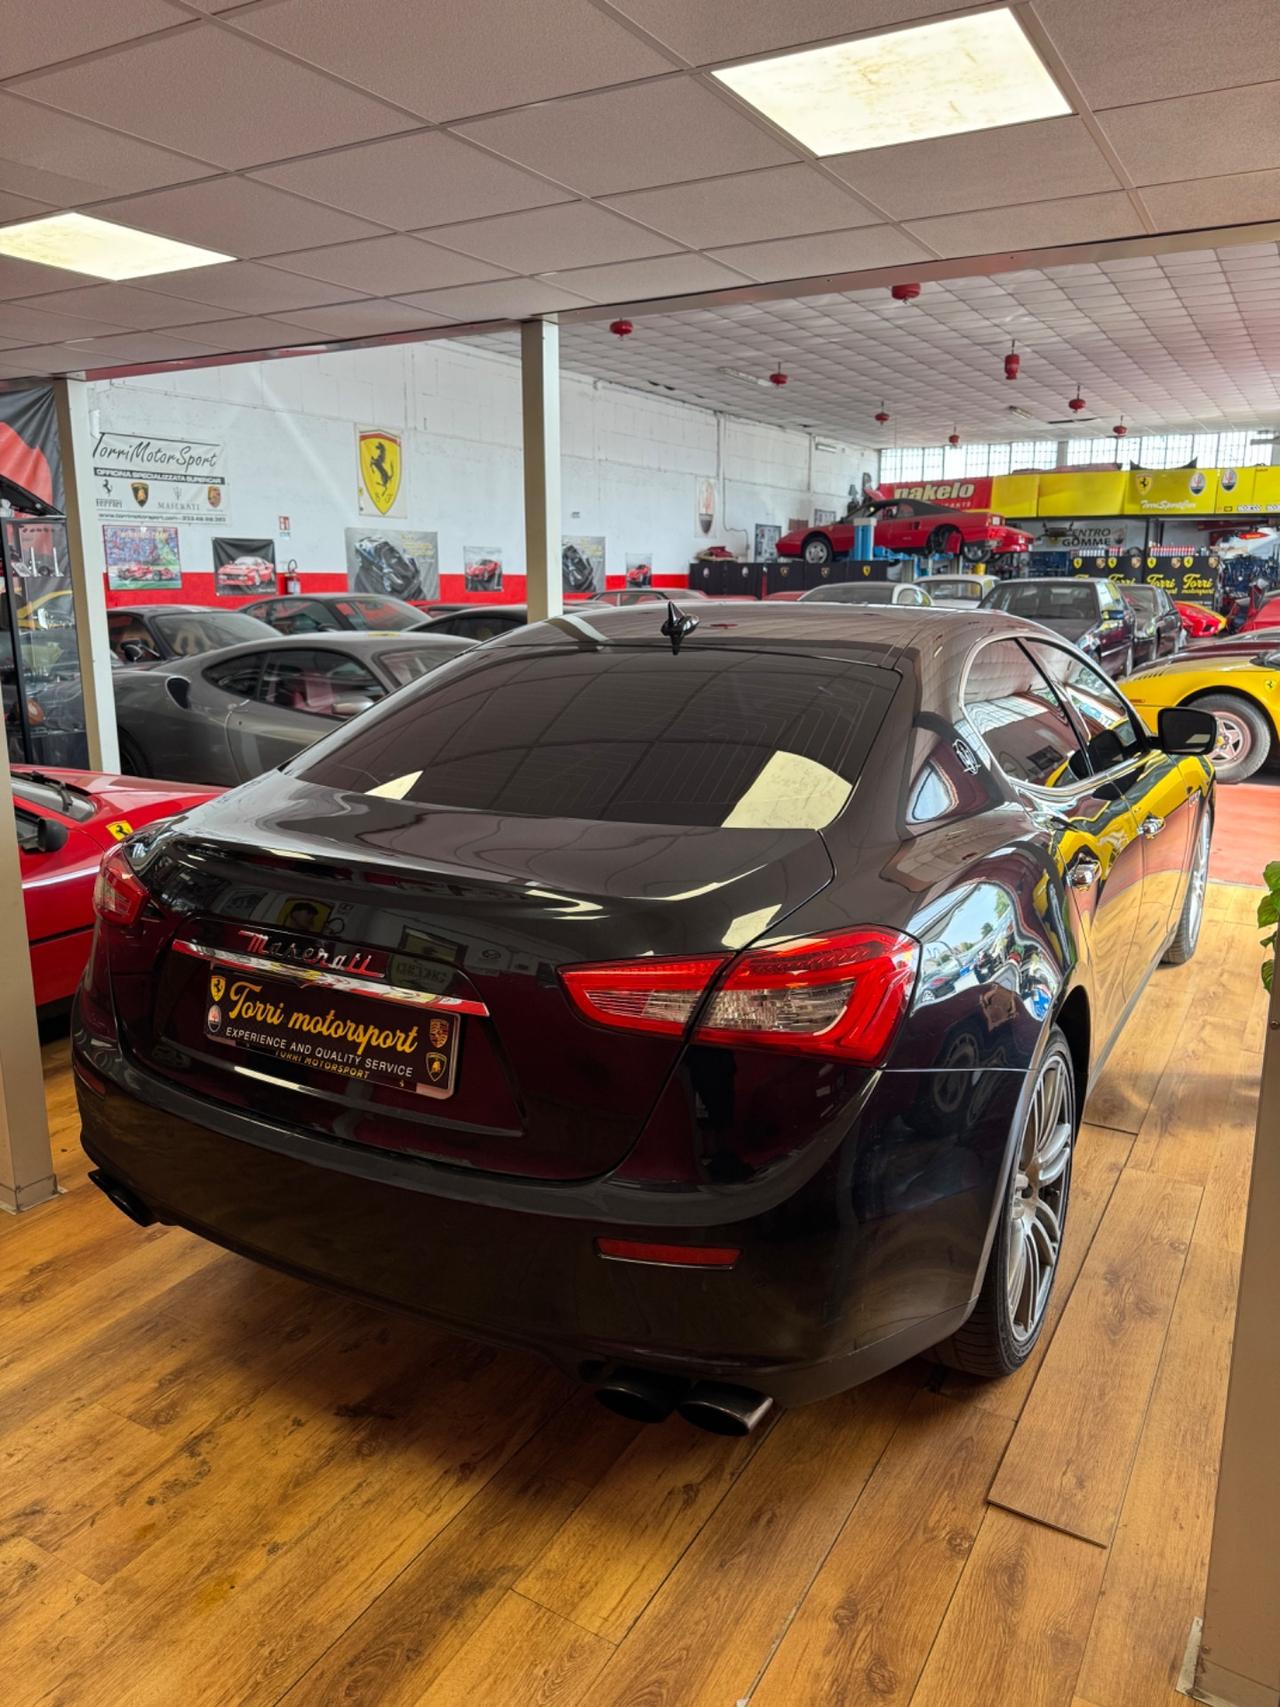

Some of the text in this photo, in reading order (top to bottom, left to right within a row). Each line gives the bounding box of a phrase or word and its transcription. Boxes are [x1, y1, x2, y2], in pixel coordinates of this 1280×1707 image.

[92, 432, 220, 472] TorriMotorSport
[1062, 536, 1111, 547] GOMME
[1072, 527, 1111, 538] ENTRO
[1182, 573, 1214, 590] Torri
[238, 929, 385, 979] Maserati
[229, 982, 418, 1055] Torri motorsport
[225, 1026, 413, 1078] EXPERIENCE AND QUALITY SERVICE
[303, 1055, 371, 1080] MOTORSPORT
